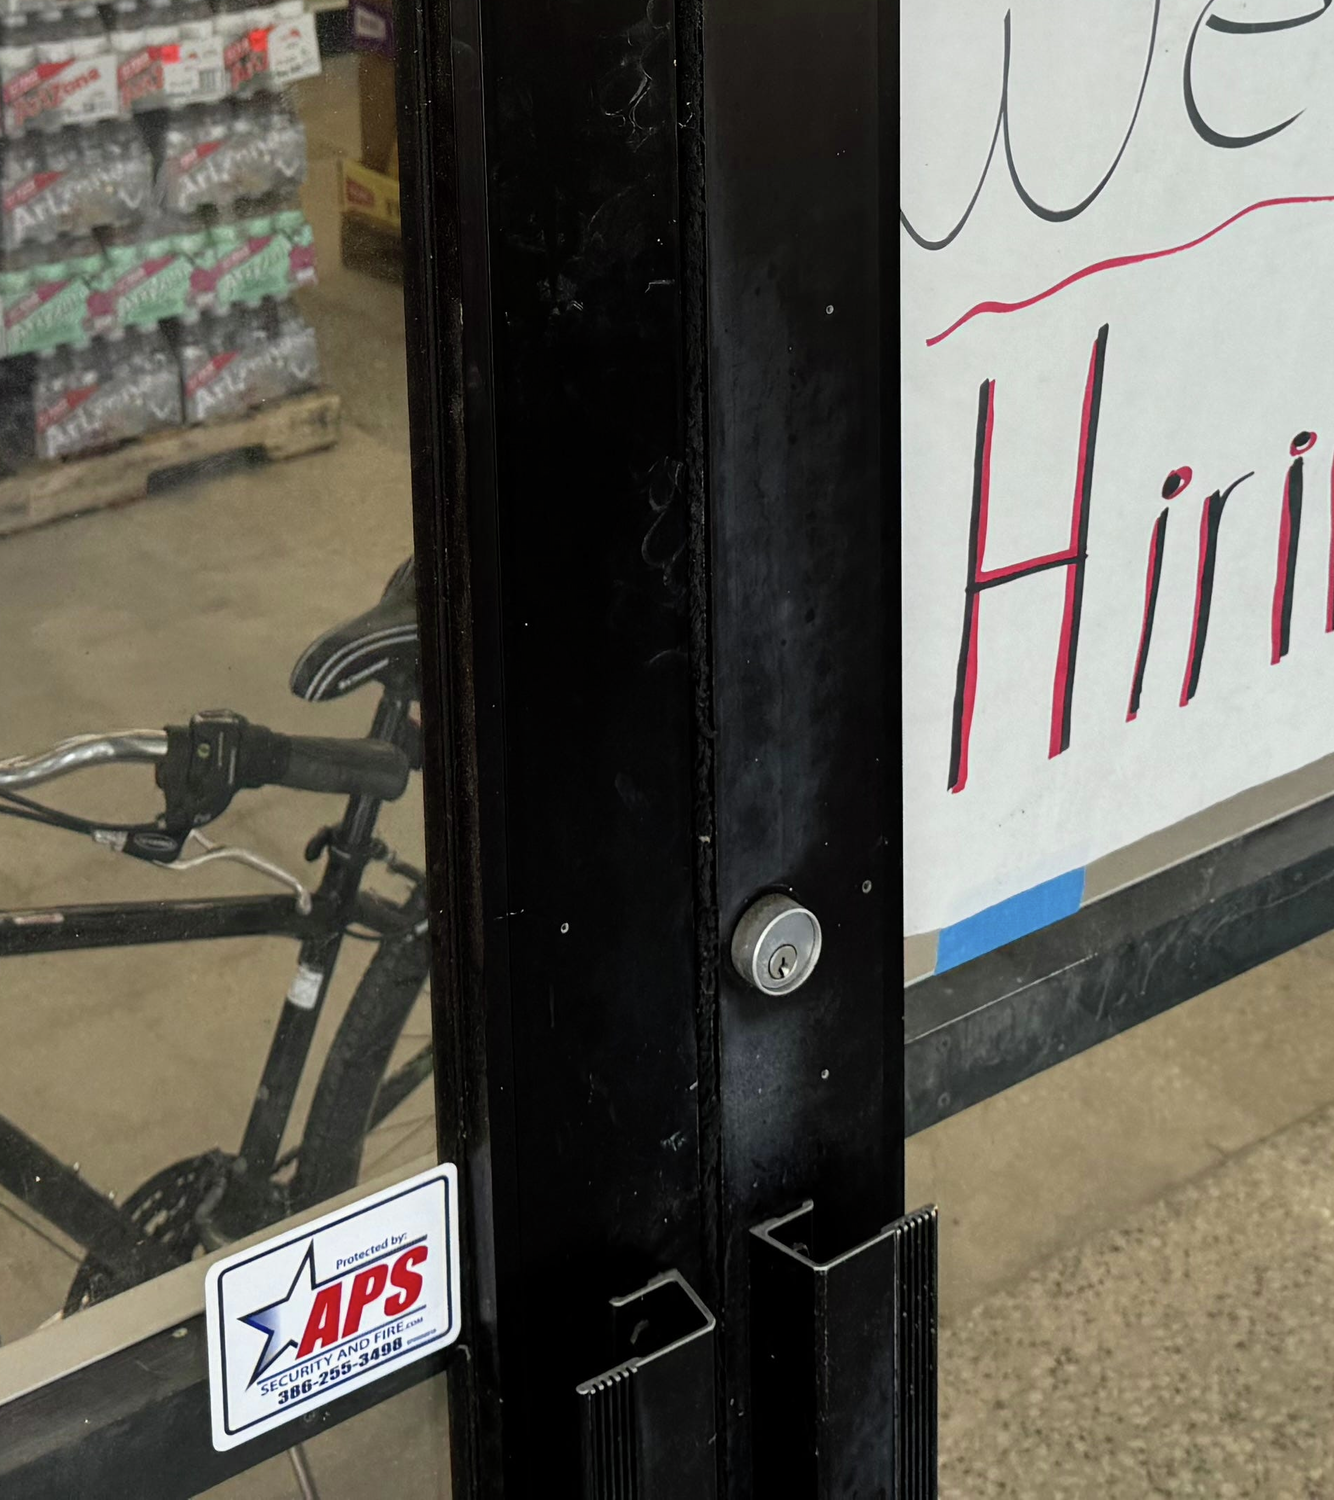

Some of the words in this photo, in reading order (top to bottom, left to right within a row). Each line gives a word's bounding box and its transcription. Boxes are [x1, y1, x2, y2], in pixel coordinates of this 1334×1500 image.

[336, 1238, 388, 1270] Protected
[390, 1232, 408, 1246] by:
[295, 1244, 429, 1360] APS
[260, 1353, 334, 1396] SECURITY
[336, 1337, 370, 1362] AND
[277, 1336, 403, 1406] 386-255-3498
